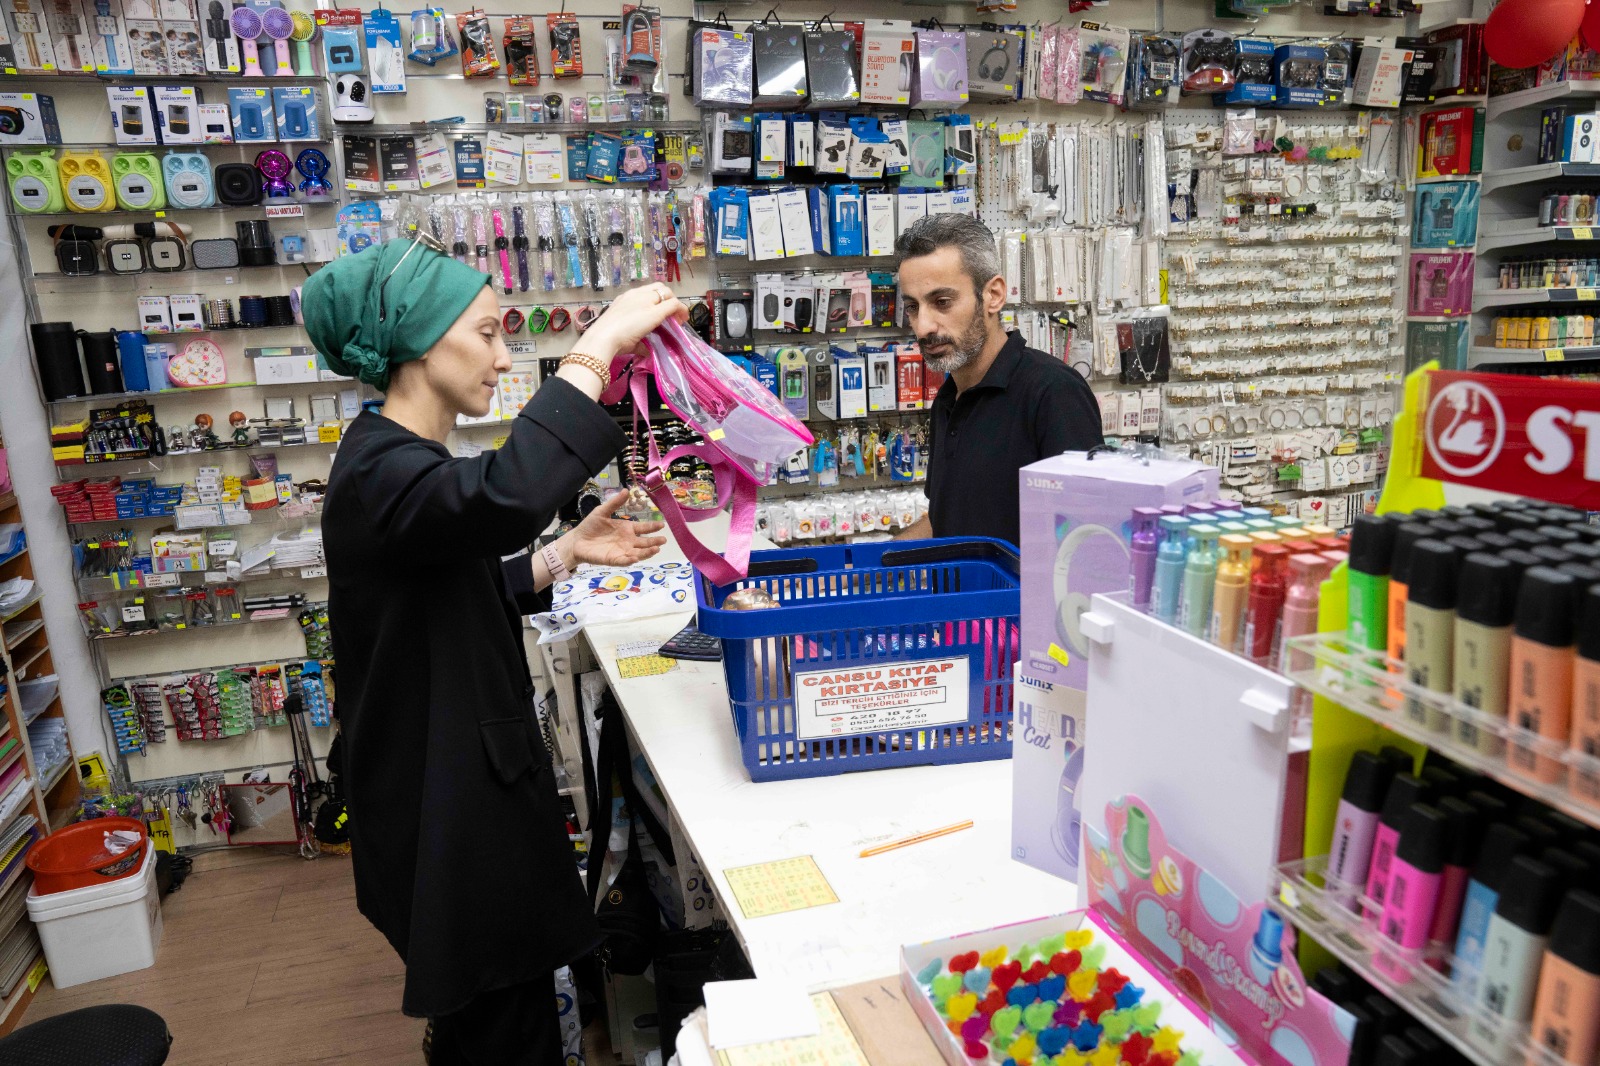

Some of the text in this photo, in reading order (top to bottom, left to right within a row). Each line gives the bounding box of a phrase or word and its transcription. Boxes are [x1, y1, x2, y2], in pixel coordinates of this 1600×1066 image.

[867, 55, 896, 64] BLUETOOTH
[866, 63, 885, 71] SOUND
[1437, 112, 1462, 122] PARLEMENT
[1429, 256, 1454, 264] PARLEMENT
[802, 670, 882, 687] CANSU
[1022, 726, 1051, 750] Cat
